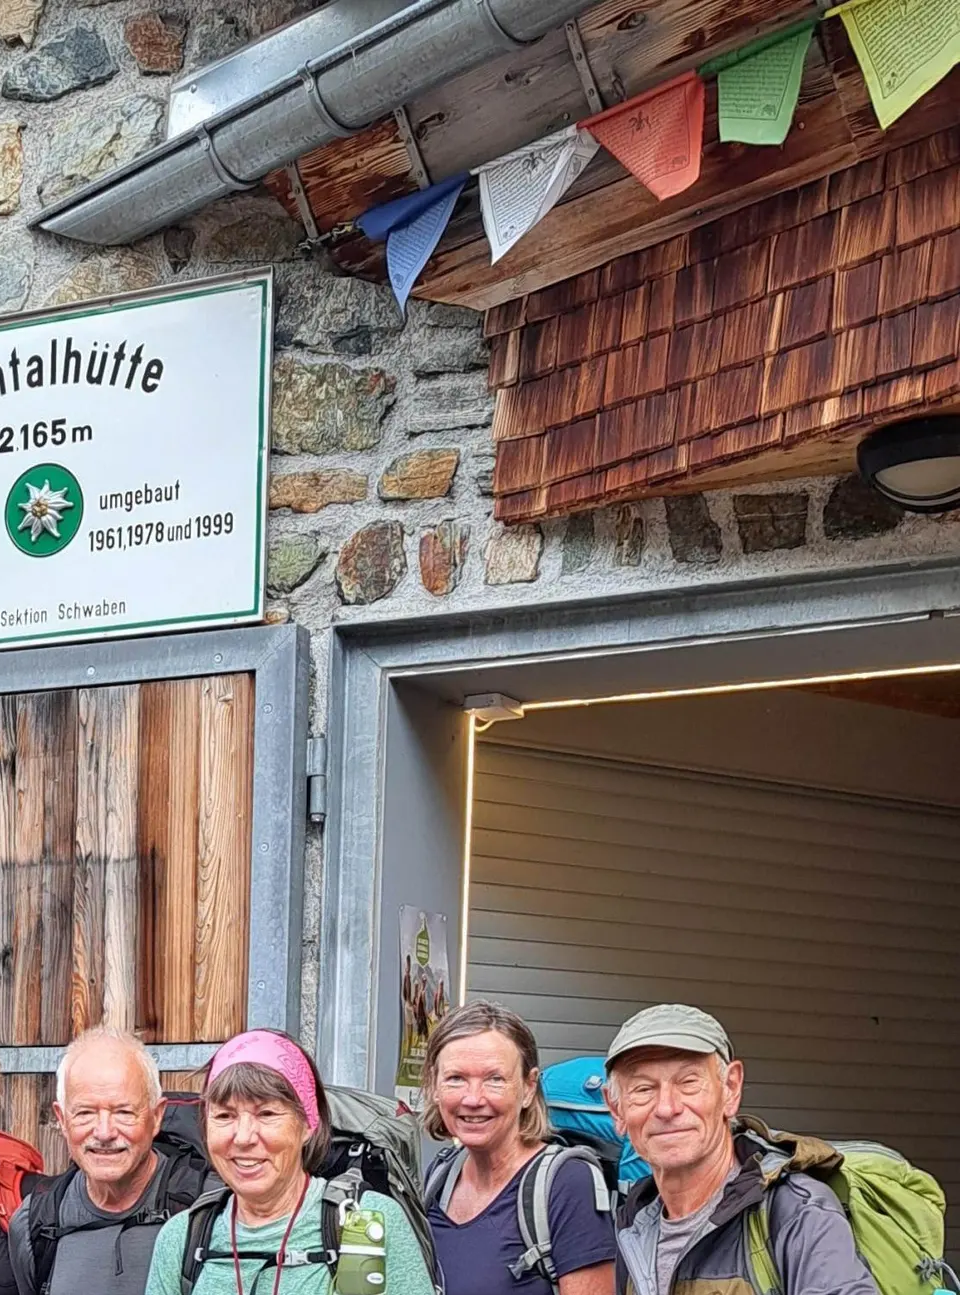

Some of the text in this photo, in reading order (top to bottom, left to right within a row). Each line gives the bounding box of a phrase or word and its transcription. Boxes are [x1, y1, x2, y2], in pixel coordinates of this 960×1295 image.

[99, 479, 180, 513] umgebaut
[167, 518, 192, 542] und
[194, 512, 234, 538] 1999
[0, 607, 48, 627] Sektion
[57, 599, 127, 620] Schwaben
